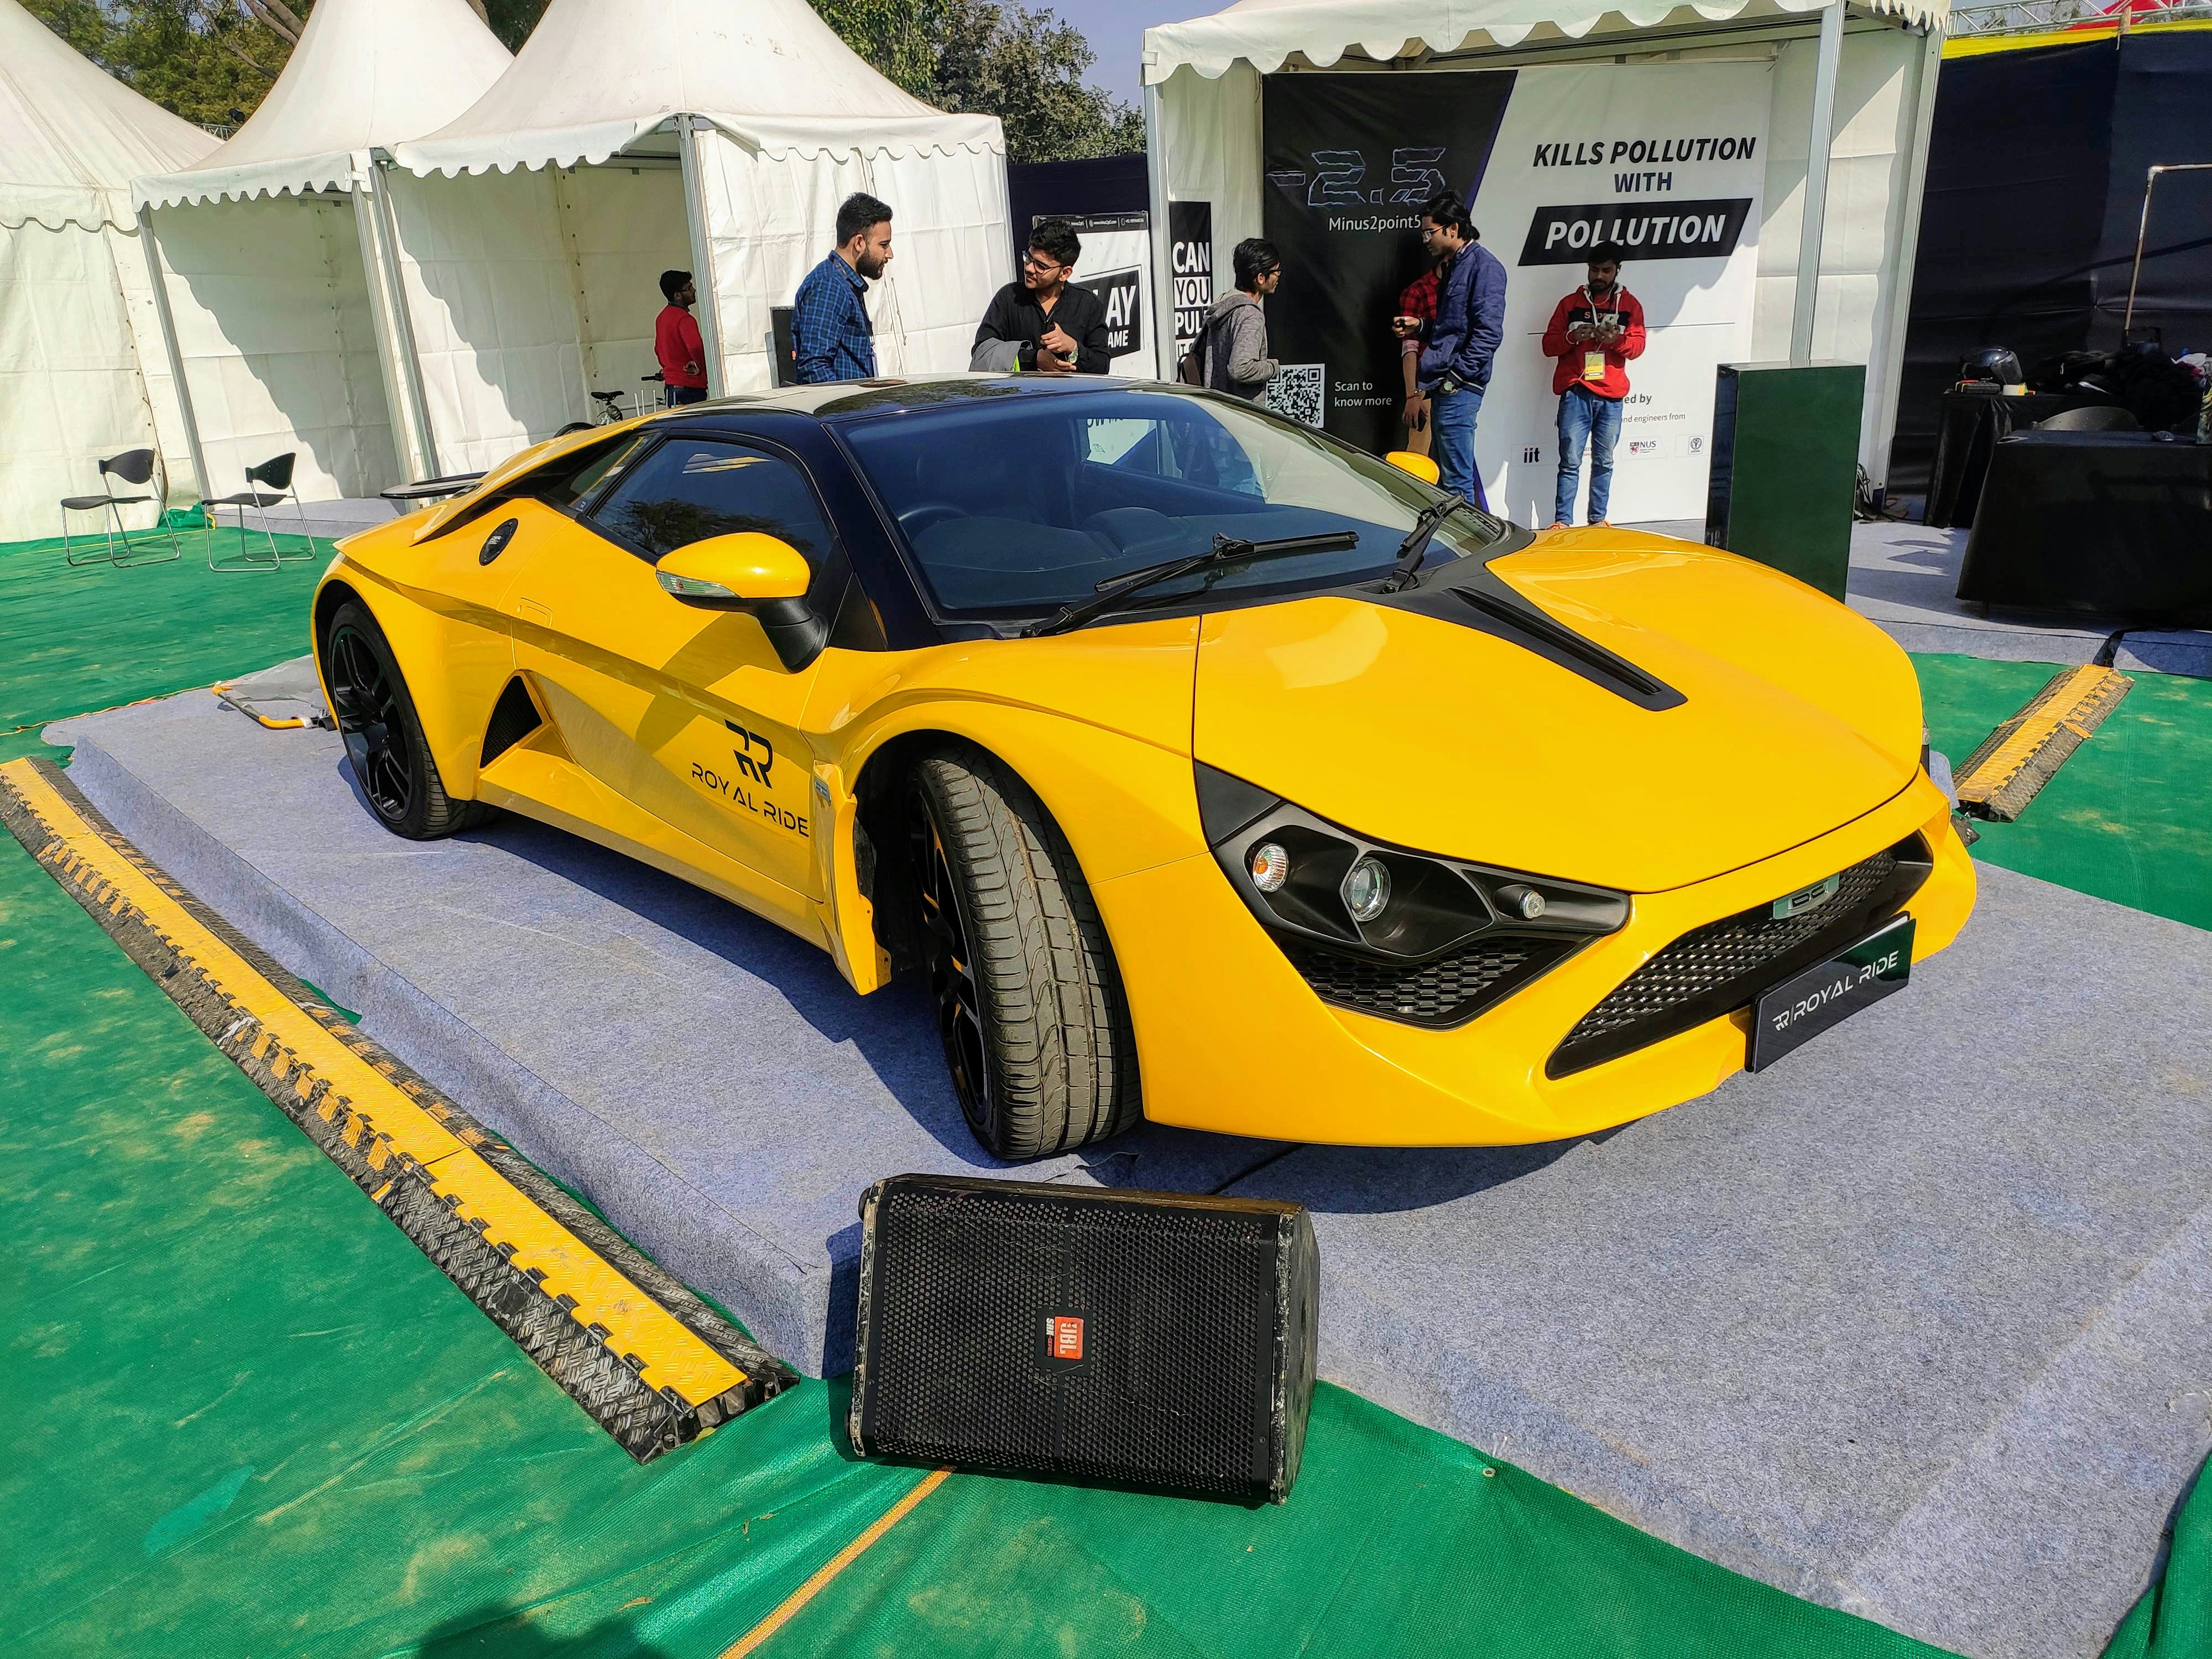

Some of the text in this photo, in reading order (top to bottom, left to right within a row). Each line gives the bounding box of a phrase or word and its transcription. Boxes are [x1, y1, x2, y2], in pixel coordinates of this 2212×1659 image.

[1533, 137, 1757, 167] KILLS POLLUTION
[1614, 171, 1673, 193] WITH
[1329, 215, 1421, 233] Minus2point5
[1545, 214, 1726, 251] POLLUTION
[1172, 241, 1211, 274] CAN
[1176, 278, 1210, 306] YOU
[1175, 309, 1209, 336] PUL
[1107, 330, 1129, 349] AME
[1334, 381, 1373, 392] Scan to
[1334, 397, 1392, 408] know more
[1639, 393, 1652, 405] by
[1634, 414, 1668, 424] engineers
[1524, 447, 1540, 463] iit
[691, 761, 810, 838] ROYAL RIDE
[1793, 975, 1854, 1021] ROYAL
[1859, 950, 1900, 984] RIDE
[1060, 1323, 1078, 1354] JBL
